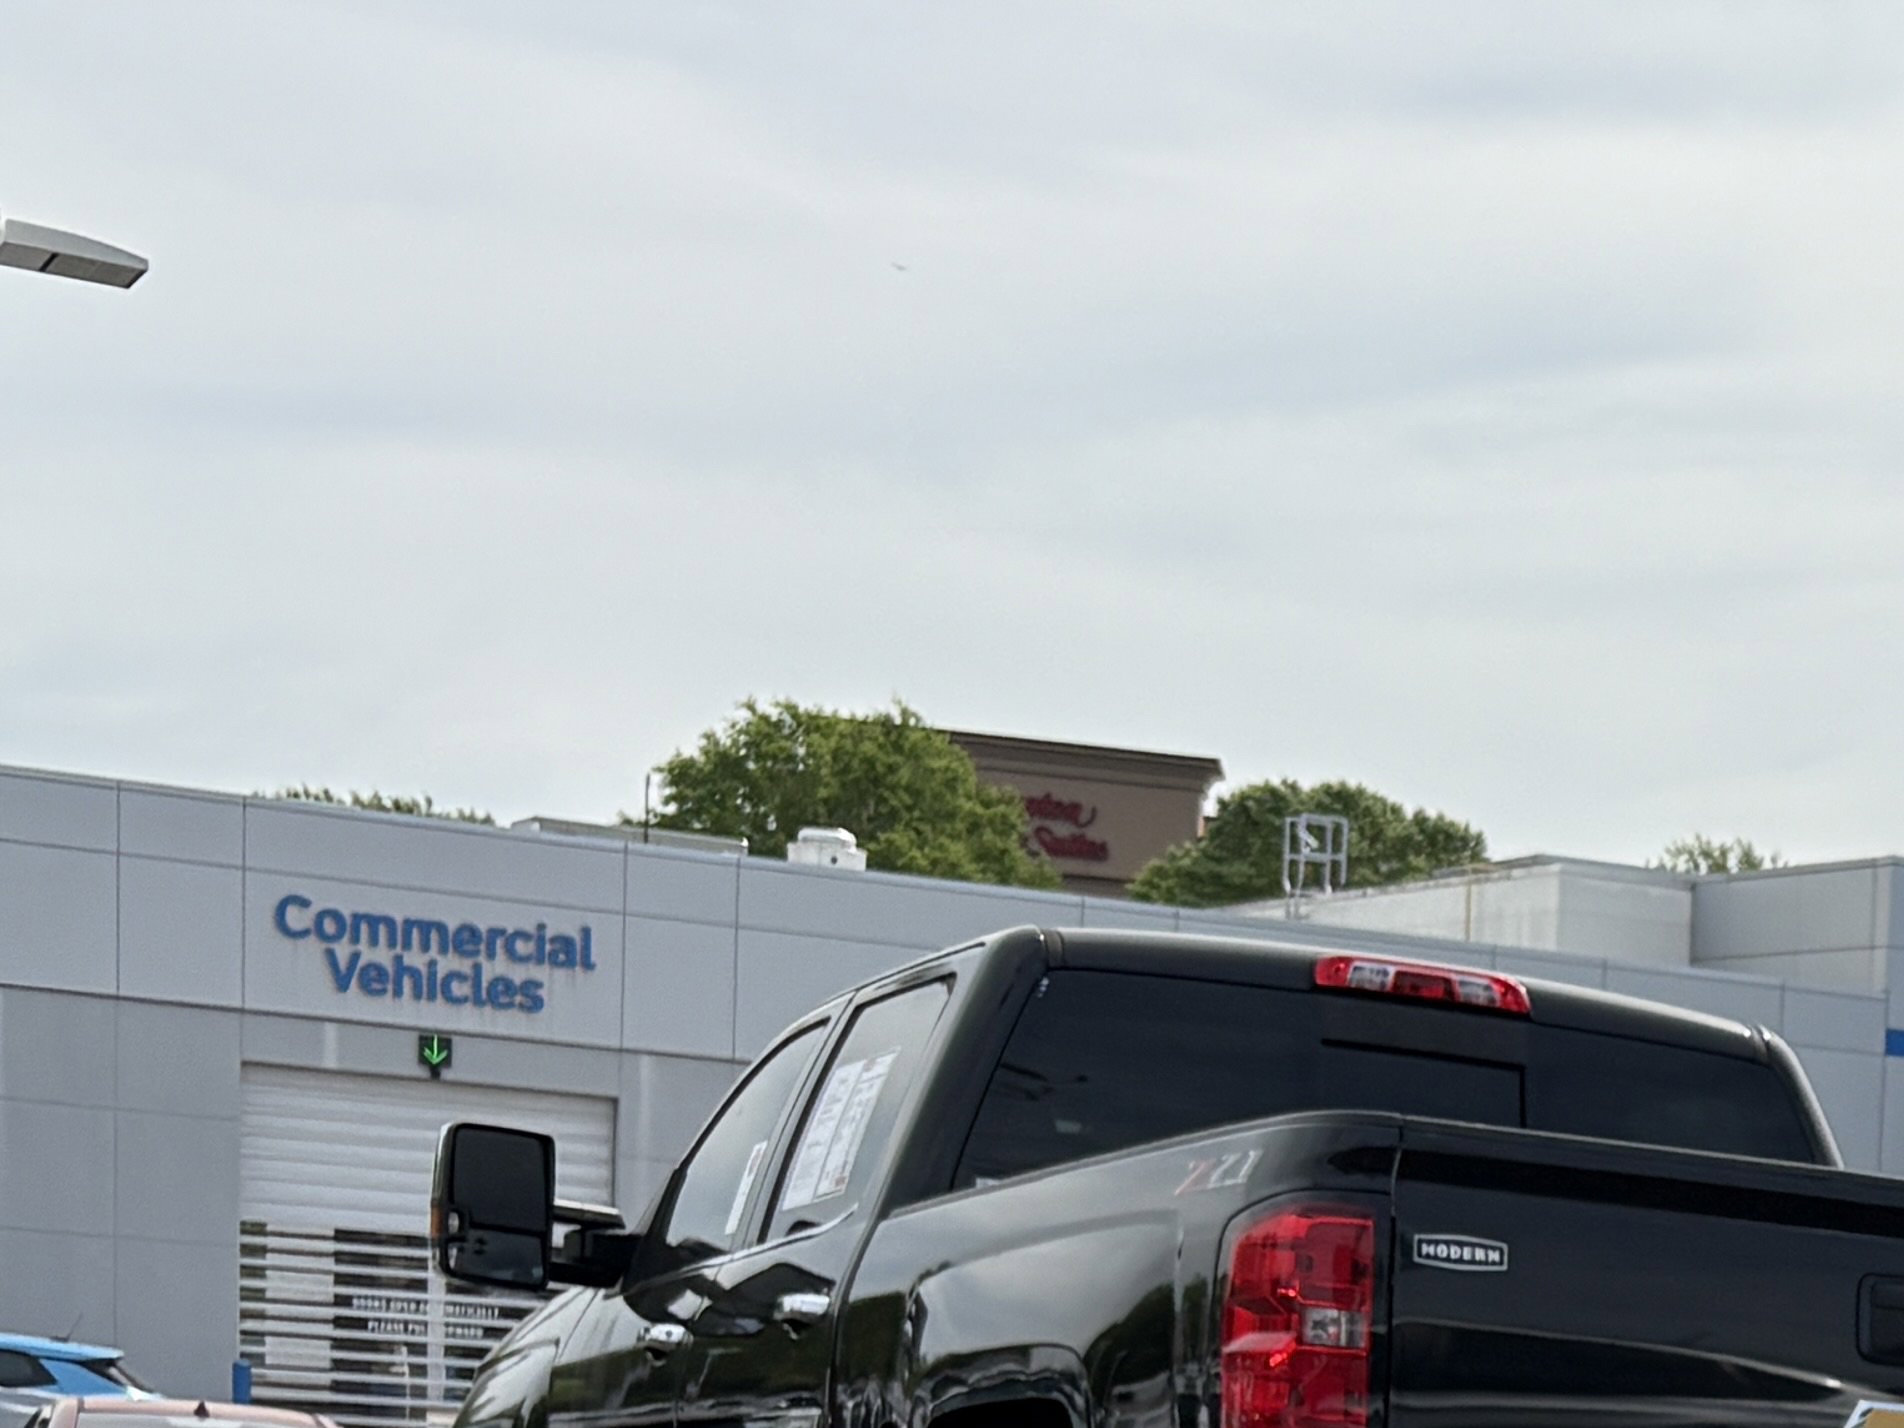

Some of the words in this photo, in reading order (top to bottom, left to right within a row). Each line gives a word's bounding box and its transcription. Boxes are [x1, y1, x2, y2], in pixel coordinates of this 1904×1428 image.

[274, 894, 596, 971] Commercial
[325, 948, 545, 1014] Vehicles
[1421, 1242, 1500, 1263] MODERN
